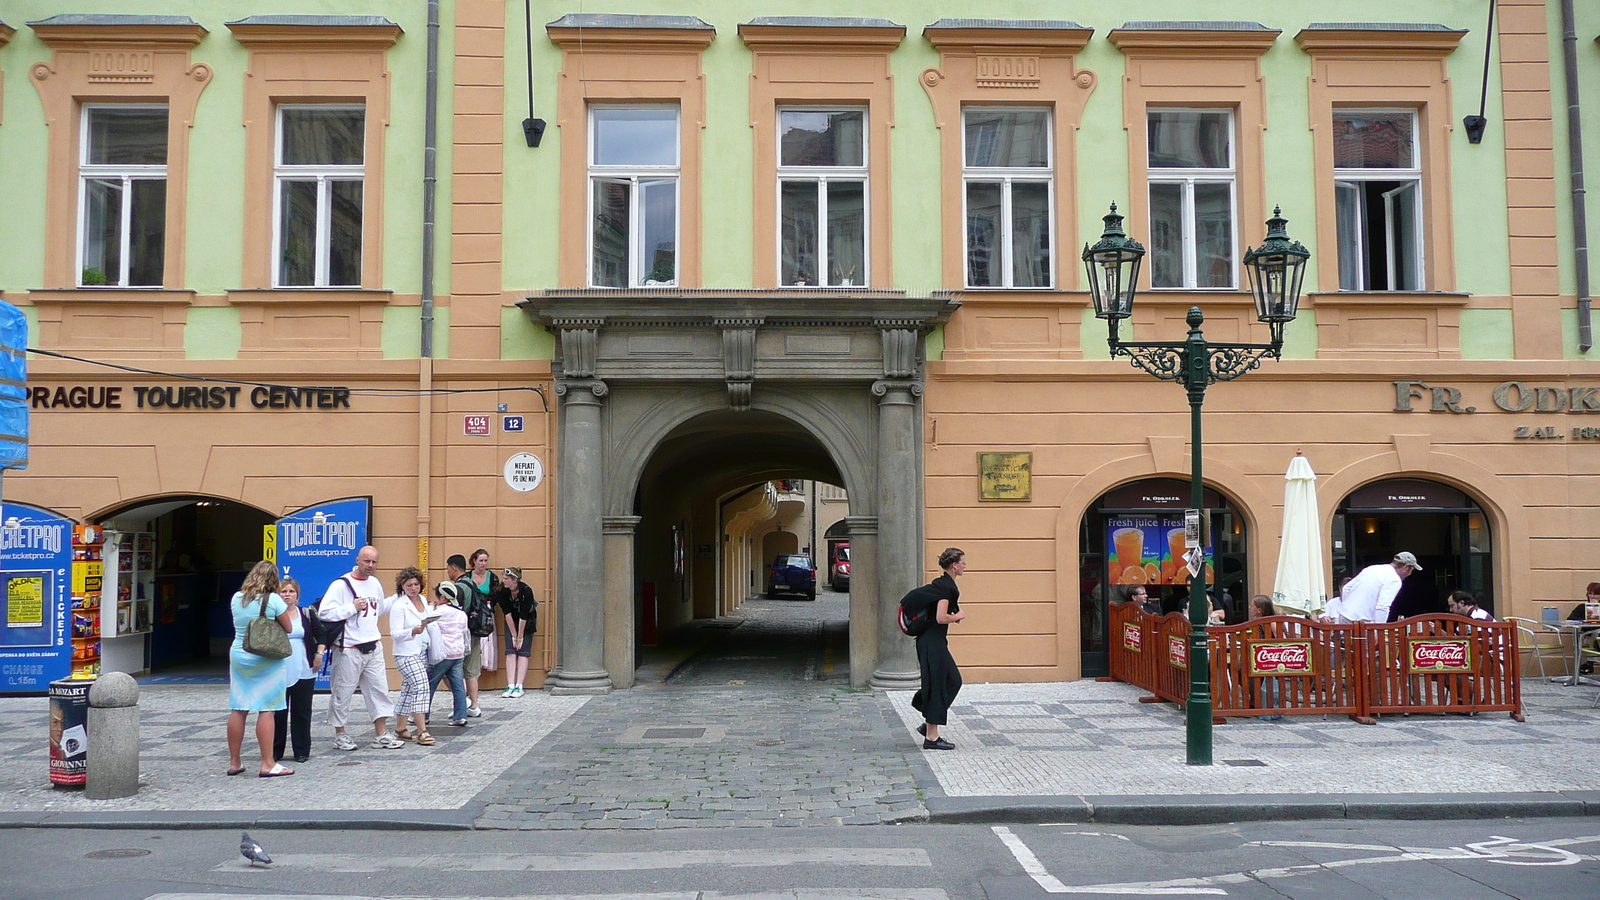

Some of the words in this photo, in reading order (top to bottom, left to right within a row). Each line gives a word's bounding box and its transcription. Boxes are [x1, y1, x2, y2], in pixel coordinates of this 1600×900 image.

[133, 386, 241, 408] TOURIST
[251, 386, 350, 408] CENTER
[468, 417, 486, 426] 404
[508, 419, 519, 429] 12
[1514, 426, 1565, 440] ZAL.
[1108, 519, 1133, 527] Fresh
[1135, 519, 1159, 528] juice
[281, 521, 356, 551] TICKETPRO
[288, 549, 350, 557] www.ticketpro.cz
[57, 568, 66, 645] e-TICKETS
[2, 664, 44, 675] CHANGE
[50, 759, 87, 769] GIOVANNI
